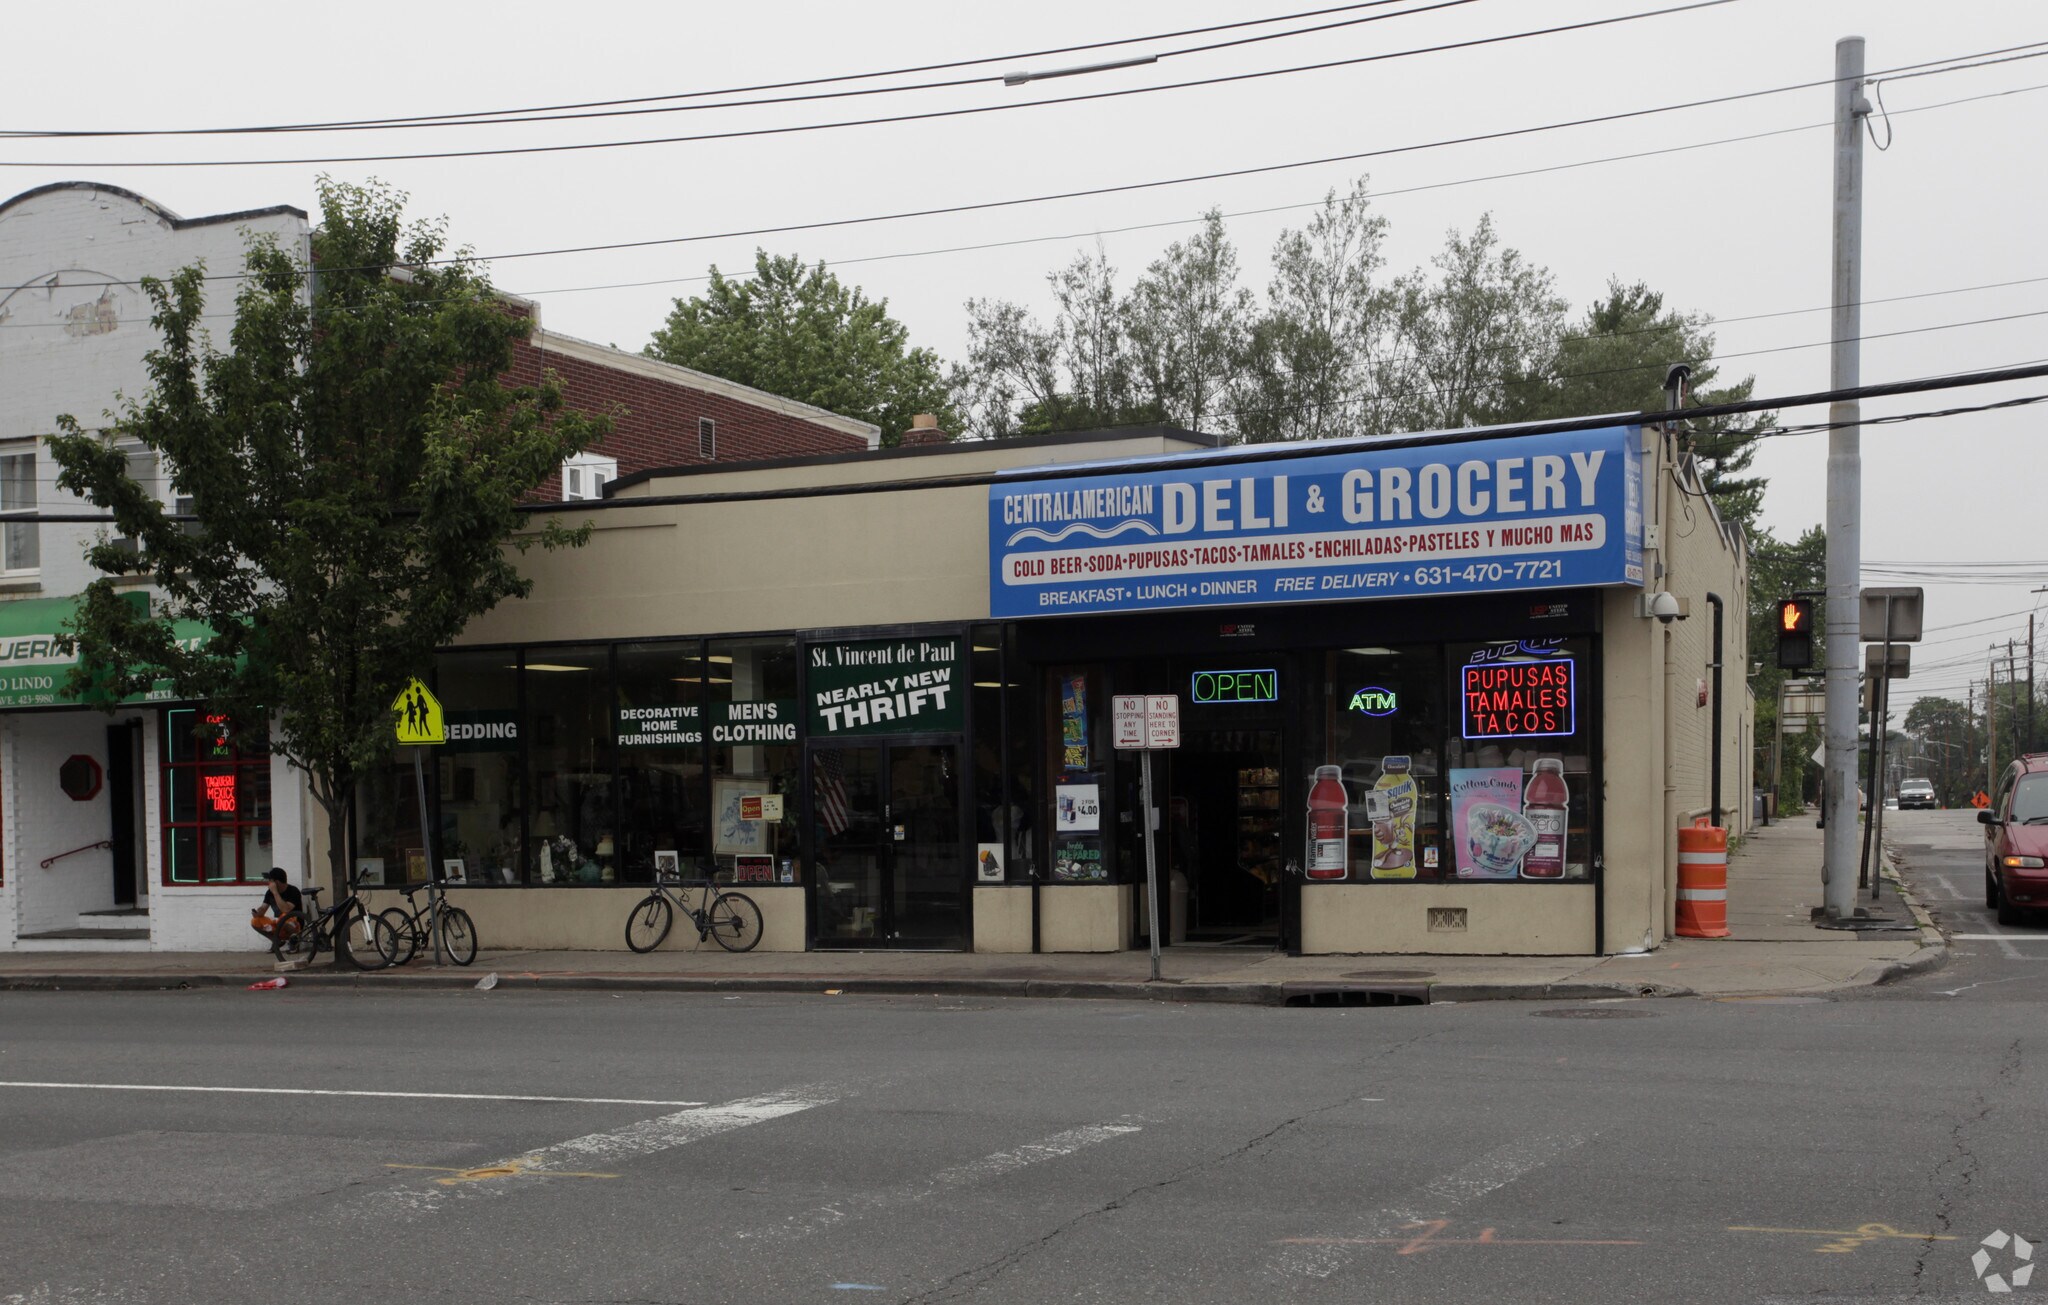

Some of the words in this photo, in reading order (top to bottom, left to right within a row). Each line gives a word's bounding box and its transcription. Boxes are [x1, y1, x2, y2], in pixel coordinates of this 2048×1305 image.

[1004, 484, 1153, 525] CENTRALAMERICAN
[1162, 475, 1289, 535] DELI
[1306, 484, 1325, 514] &
[1341, 450, 1606, 524] GROCERY
[1013, 560, 1044, 578] COLD
[1051, 557, 1083, 575] BEER
[1089, 554, 1122, 573] SODA
[1128, 549, 1188, 570] PUPUSAS
[1193, 545, 1237, 565] TACOS
[1242, 541, 1305, 563] TAMALES
[1315, 536, 1402, 559] ENCHILADAS
[1409, 530, 1480, 553] PASTELES
[1486, 529, 1495, 547] Y
[1501, 525, 1553, 547] MUCHO
[1560, 522, 1593, 543] MAS
[1039, 587, 1125, 606] BREAKFAST
[1137, 583, 1187, 600] LUNCH
[1200, 580, 1257, 596] DINNER
[1274, 576, 1315, 592] FREE
[1321, 571, 1399, 590] DELIVERY
[1414, 560, 1562, 586] 631-470-7721
[812, 647, 832, 668] St.
[836, 645, 893, 666] Vincent
[896, 643, 915, 663] de
[920, 641, 955, 662] Paul
[1470, 643, 1517, 664] BUD
[11, 676, 53, 690] LINDO
[1467, 666, 1567, 690] PUPUSAS
[816, 678, 898, 706] NEARLY
[903, 667, 951, 689] NEW
[1195, 673, 1273, 701] OPEN
[820, 683, 951, 732] THRIFT
[1124, 700, 1135, 710] NO
[1156, 700, 1168, 710] NO
[1349, 693, 1396, 710] ATM
[1466, 688, 1567, 712] TAMALES
[620, 706, 698, 720] DECORATIVE
[728, 703, 777, 720] MEN'S
[1116, 712, 1144, 720] STOPPING
[1149, 712, 1176, 720] STANDING
[641, 720, 678, 732] HOME
[1473, 711, 1556, 733] TACOS
[444, 722, 517, 740] BEDDING
[618, 732, 702, 746] FURNISHINGS
[712, 723, 796, 742] CLOTHING
[1453, 779, 1489, 793] Cotton
[1490, 778, 1518, 792] Candy
[214, 798, 235, 811] LINDO
[743, 805, 760, 813] Open
[1078, 805, 1098, 815] $4.00
[1531, 819, 1560, 831] zero
[1057, 850, 1100, 860] PREPARED
[739, 865, 772, 881] OPEN
